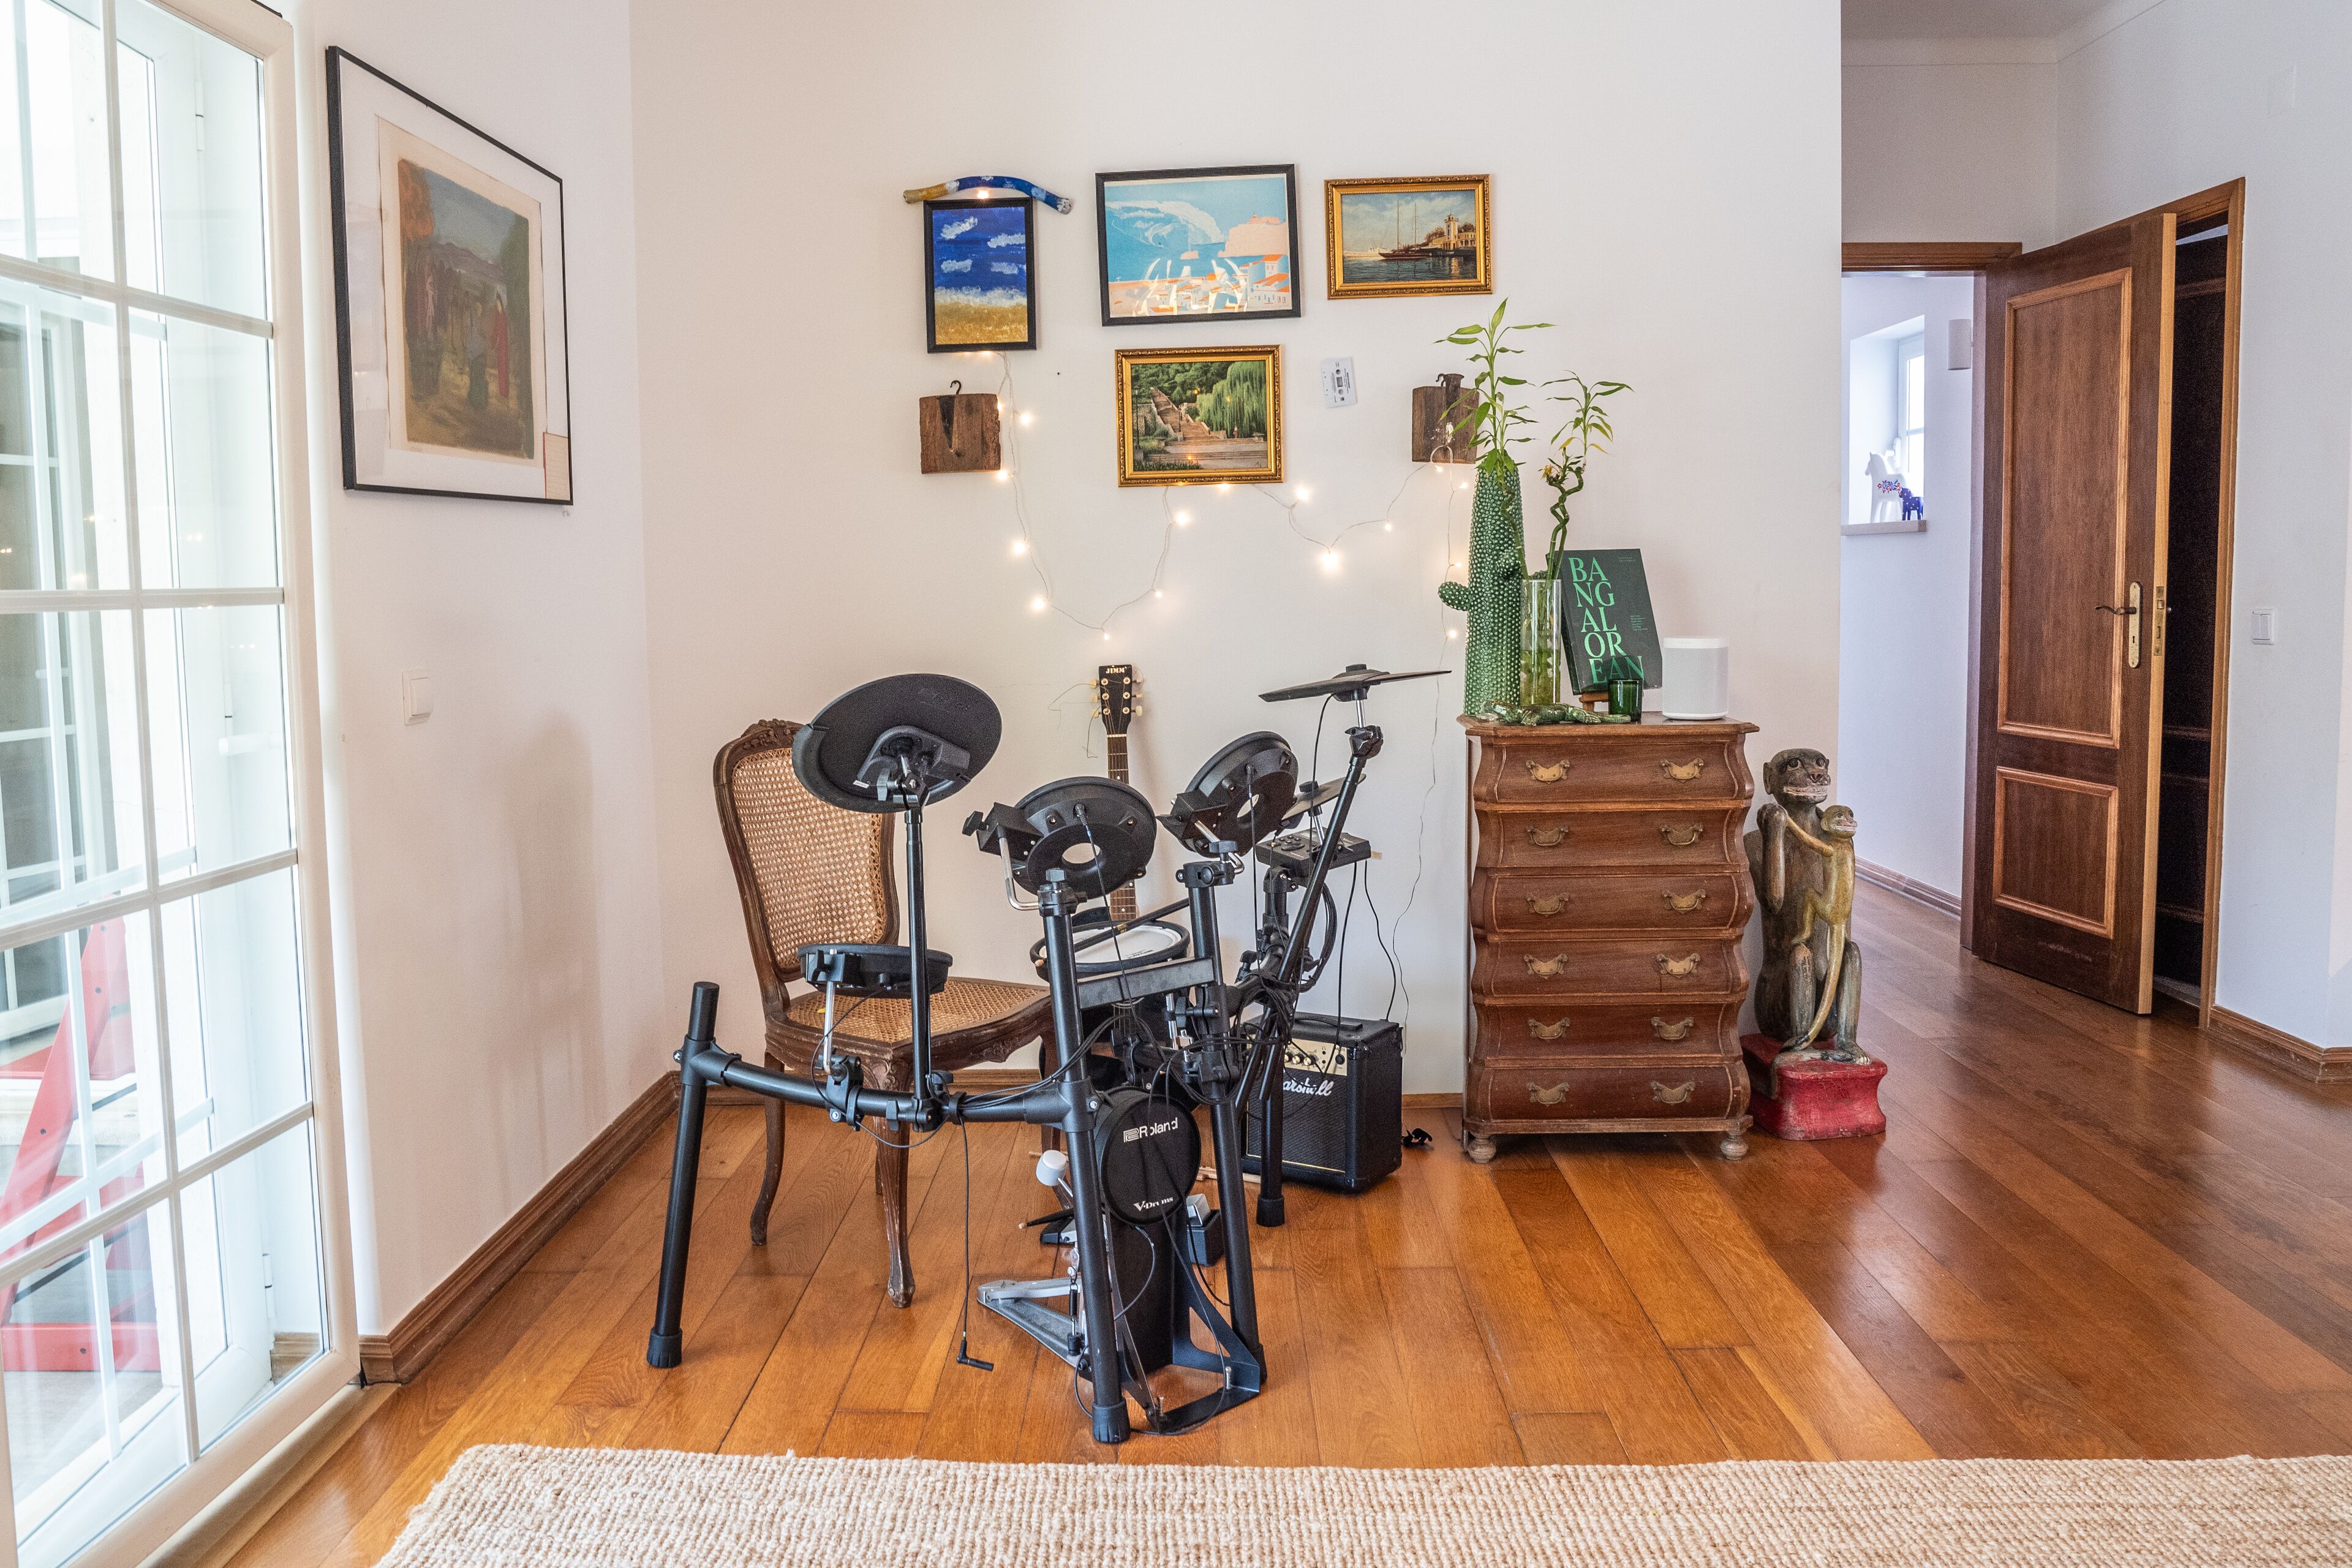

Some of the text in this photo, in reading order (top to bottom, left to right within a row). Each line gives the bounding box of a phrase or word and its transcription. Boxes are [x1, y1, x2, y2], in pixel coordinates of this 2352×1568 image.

[1568, 557, 1608, 582] BA
[1572, 581, 1616, 607] NG
[1580, 606, 1618, 632] AL
[1584, 631, 1627, 658] OR
[1588, 655, 1645, 684] EAN
[1283, 1077, 1335, 1096] arshall
